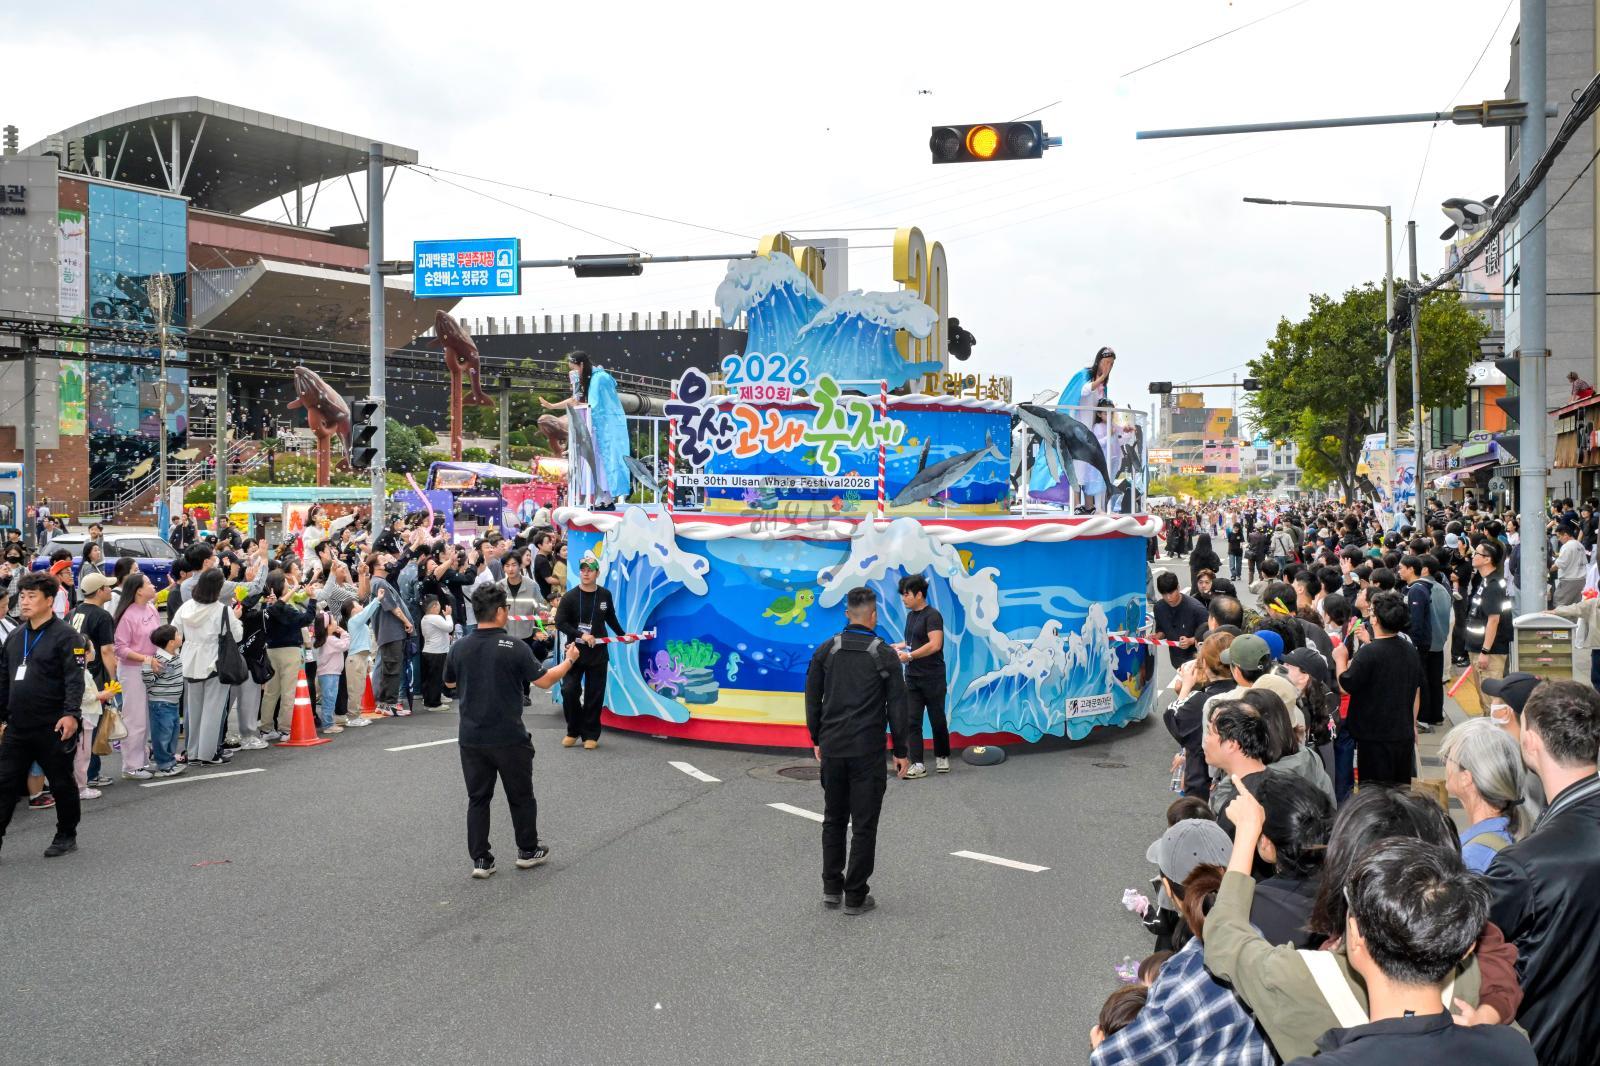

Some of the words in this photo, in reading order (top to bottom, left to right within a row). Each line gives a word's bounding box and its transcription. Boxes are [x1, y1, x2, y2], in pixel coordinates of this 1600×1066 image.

[418, 252, 455, 269] 고래박물관
[424, 271, 460, 287] 순환버스
[462, 269, 489, 286] 정류장
[723, 353, 808, 386] 2026
[739, 384, 791, 402] 제30회
[680, 475, 699, 486] The
[703, 475, 727, 486] 30th
[731, 475, 760, 487] Ulsan
